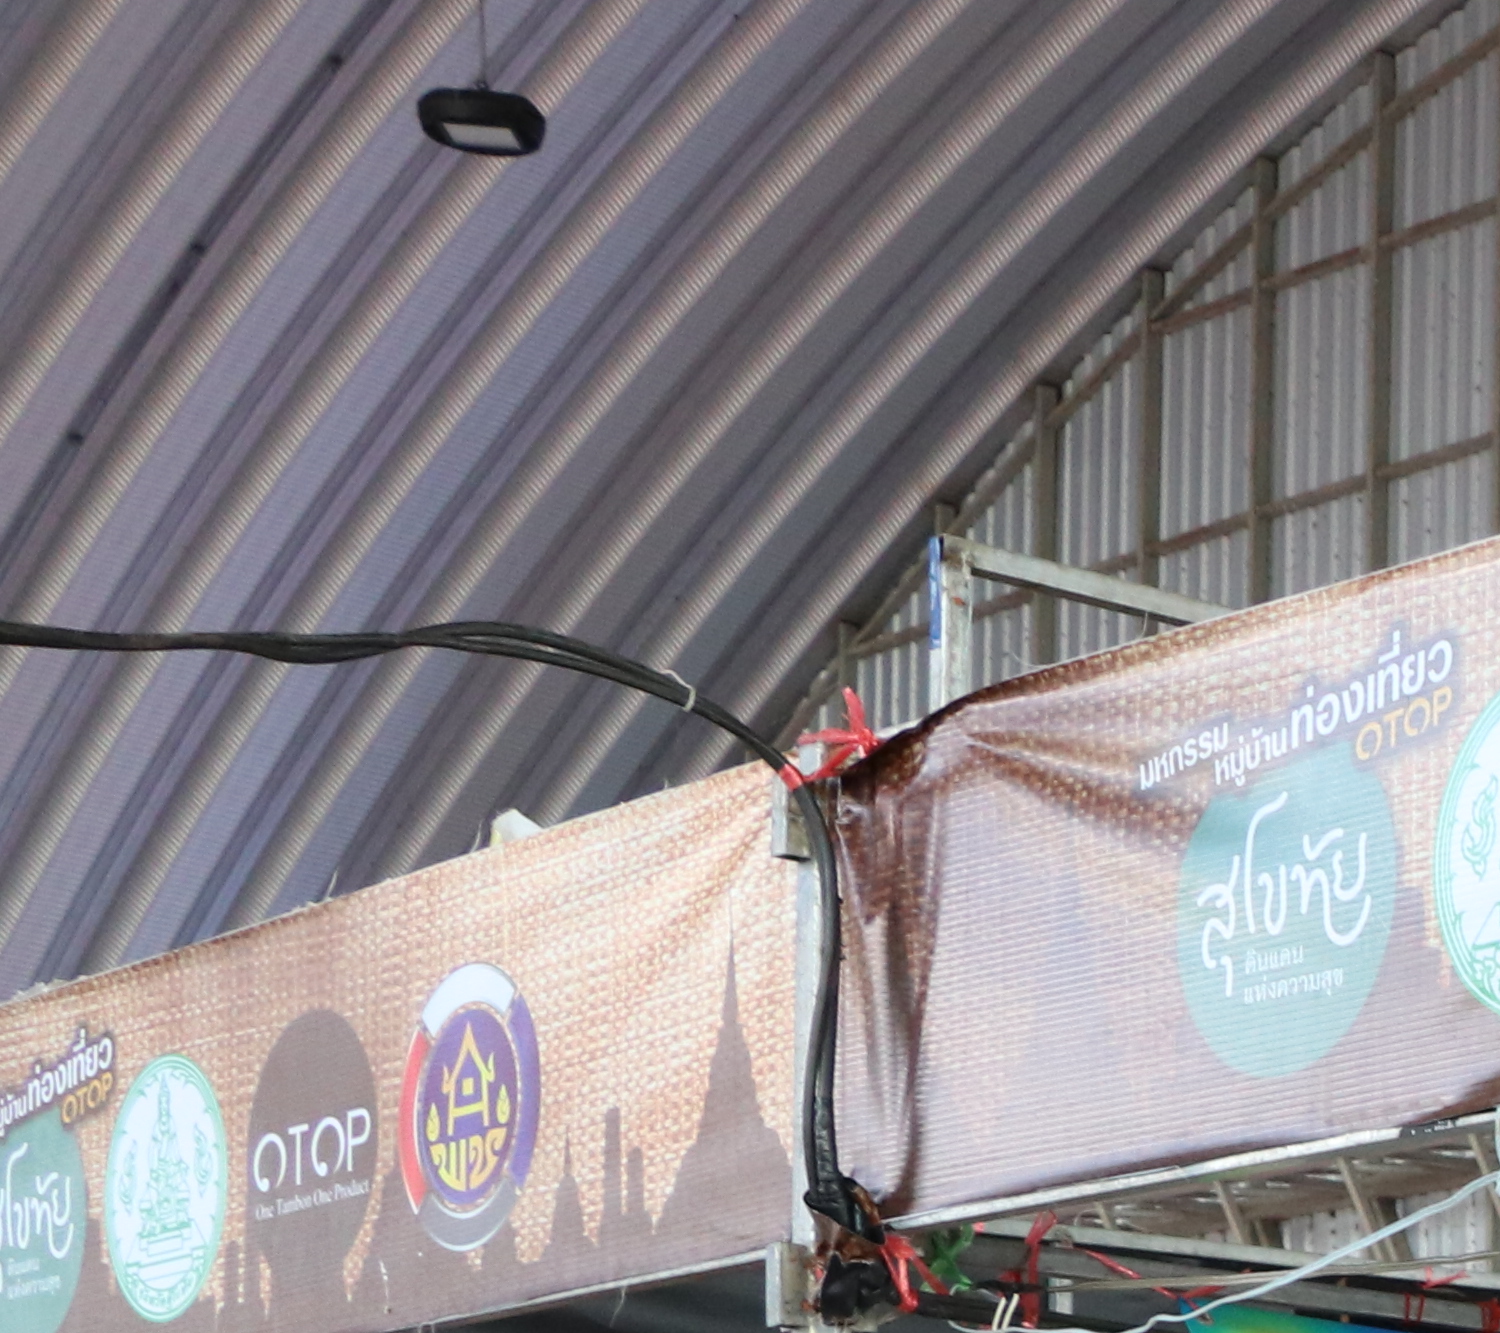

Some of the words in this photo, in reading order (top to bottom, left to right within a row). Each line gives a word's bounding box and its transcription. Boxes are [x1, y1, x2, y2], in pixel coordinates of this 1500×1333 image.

[1354, 687, 1454, 764] OTOP
[60, 1071, 114, 1124] OTOP
[252, 1109, 372, 1193] OTOP
